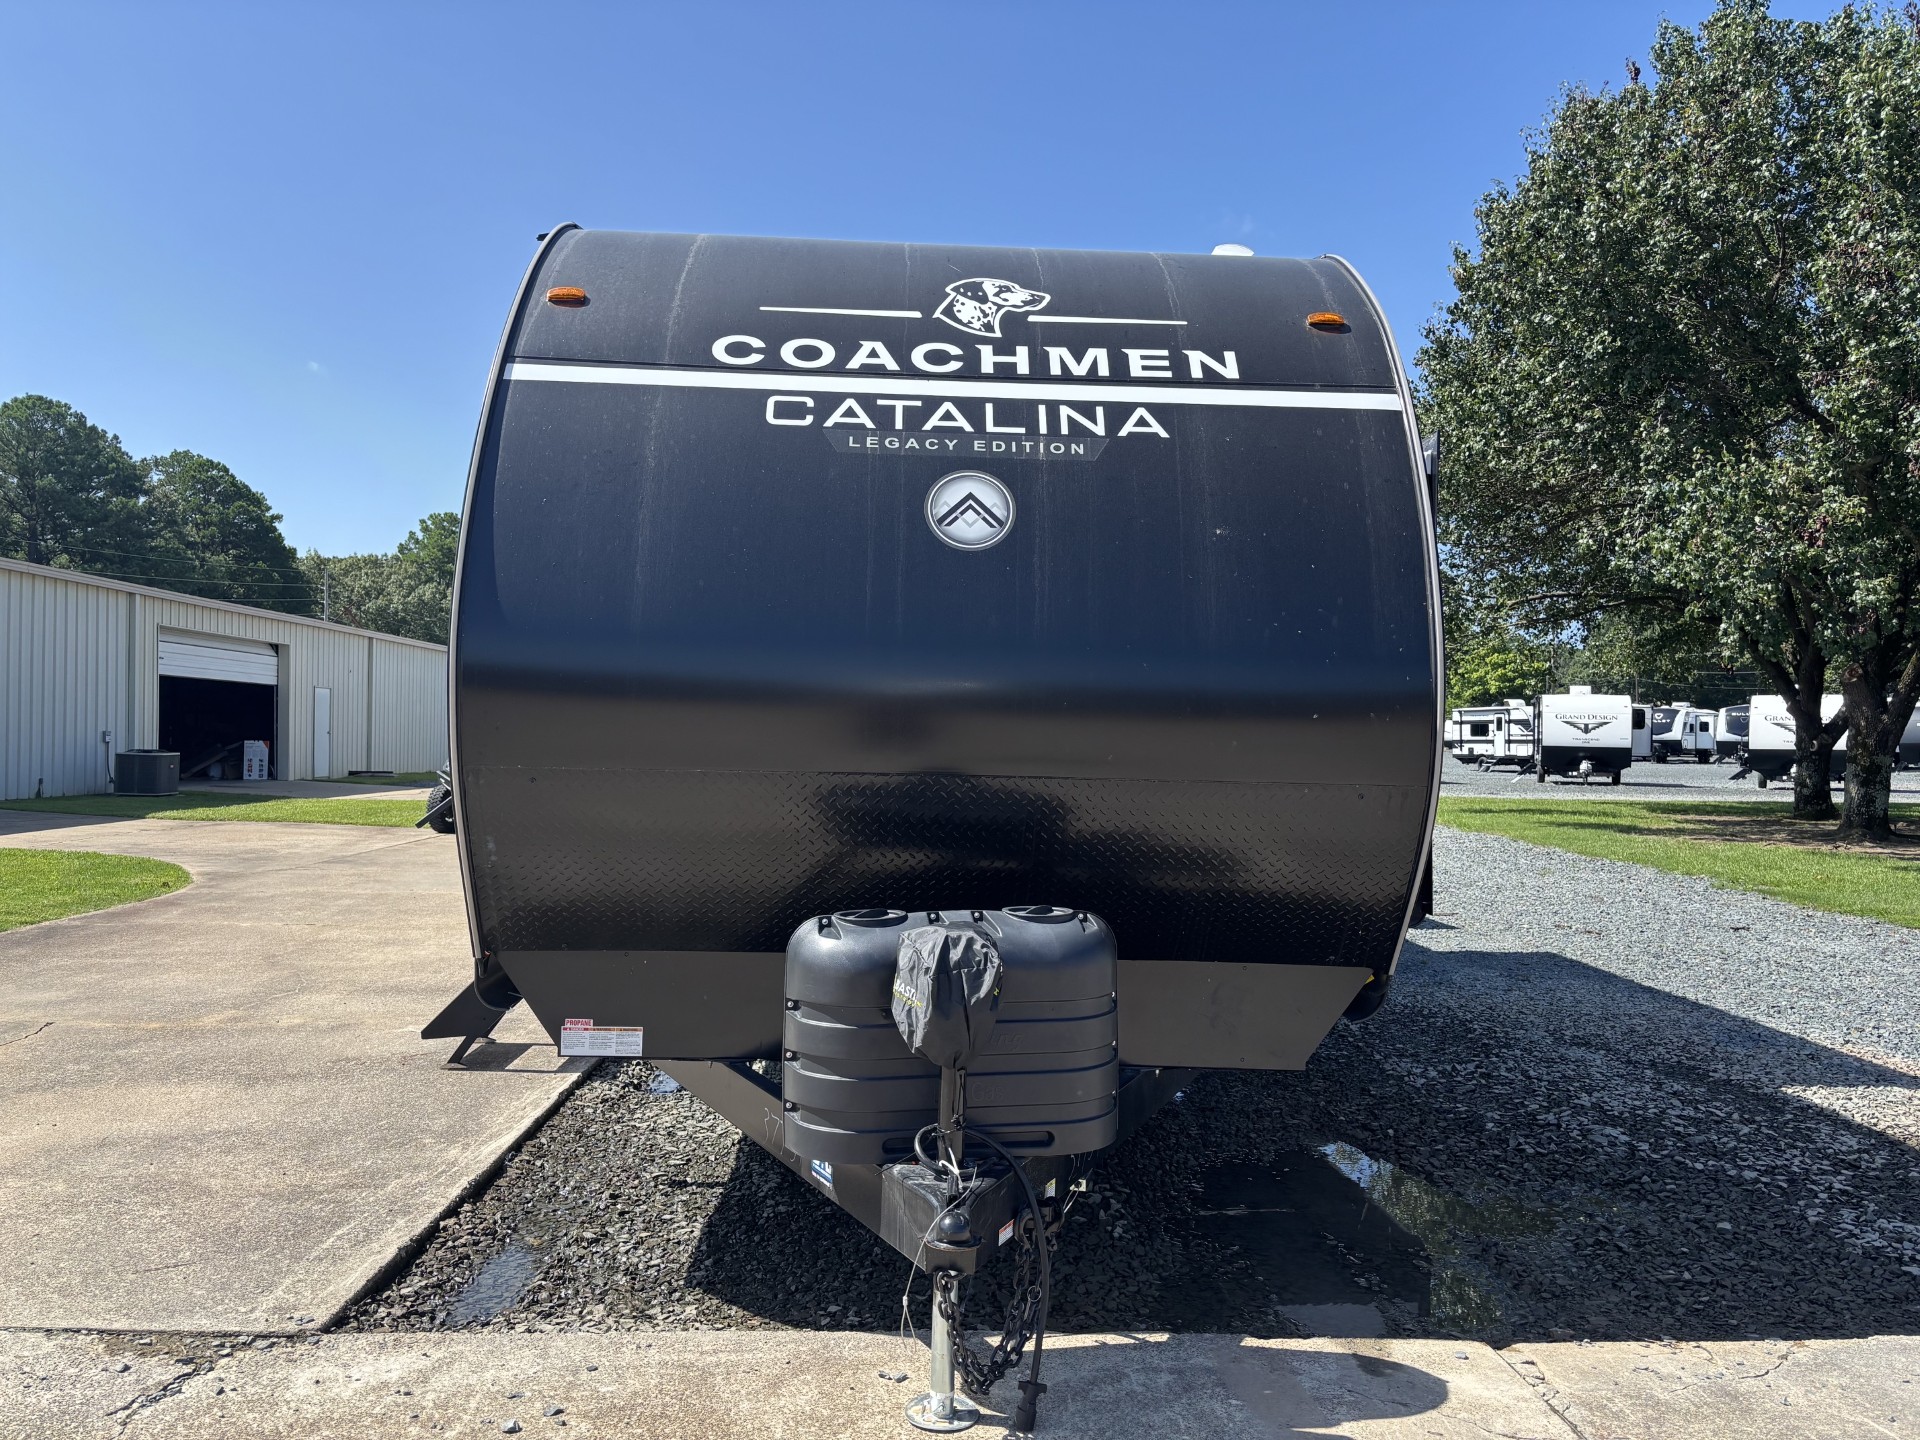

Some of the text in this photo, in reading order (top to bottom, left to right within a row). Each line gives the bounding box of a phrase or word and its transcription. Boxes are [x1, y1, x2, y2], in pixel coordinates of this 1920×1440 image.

[711, 334, 1240, 380] COACHMEN
[765, 395, 1170, 439] CATALINA
[848, 435, 1084, 455] LEGACY EDITION
[1587, 713, 1618, 721] DESIGN
